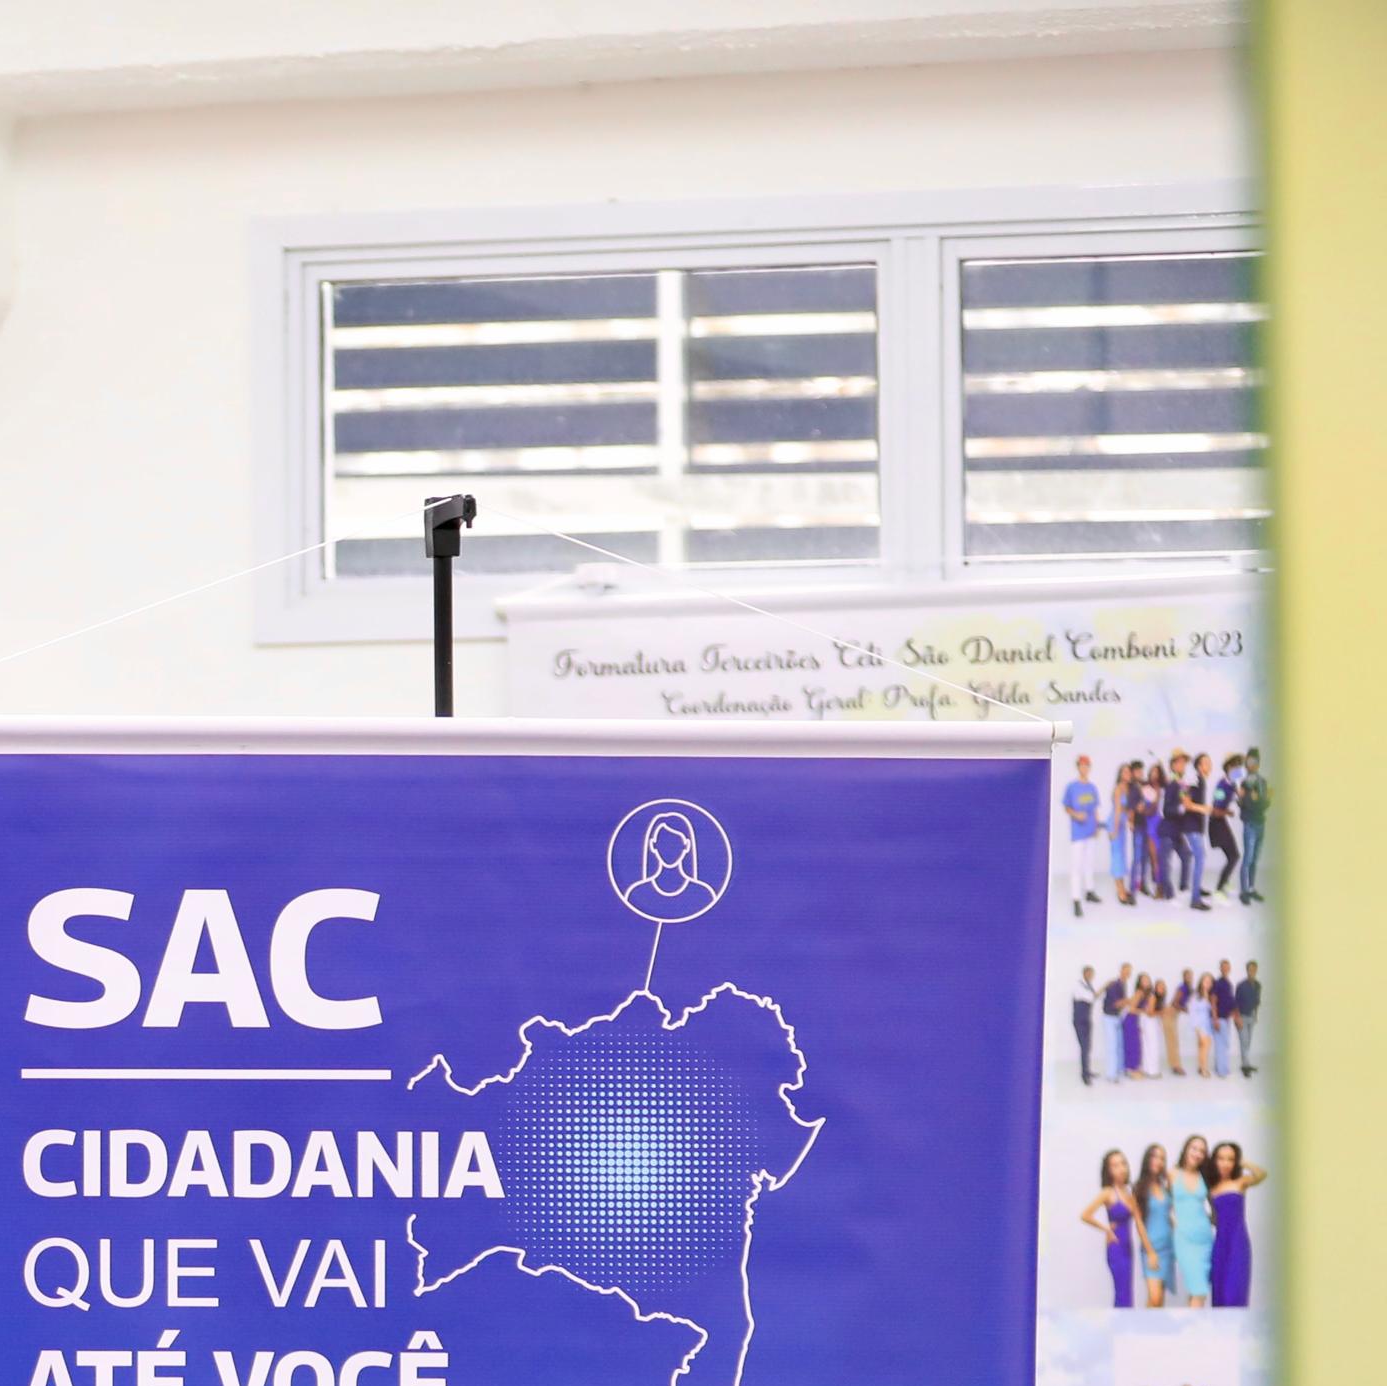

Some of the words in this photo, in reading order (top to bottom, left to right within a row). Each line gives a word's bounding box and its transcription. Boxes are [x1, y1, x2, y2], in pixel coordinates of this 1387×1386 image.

[553, 647, 687, 679] Formatura
[699, 642, 822, 673] Terceirões
[903, 637, 949, 667] São
[961, 634, 1057, 665] Daniel
[1064, 628, 1178, 663] Comboni
[1187, 629, 1244, 659] 2023
[660, 690, 794, 718] Coordenação
[968, 680, 1032, 719] Gilda
[1046, 678, 1122, 705] Sandes
[24, 887, 384, 1030] SAC
[22, 1129, 506, 1199] CIDADANIA
[23, 1237, 219, 1312] QUE
[248, 1239, 387, 1308] VAI
